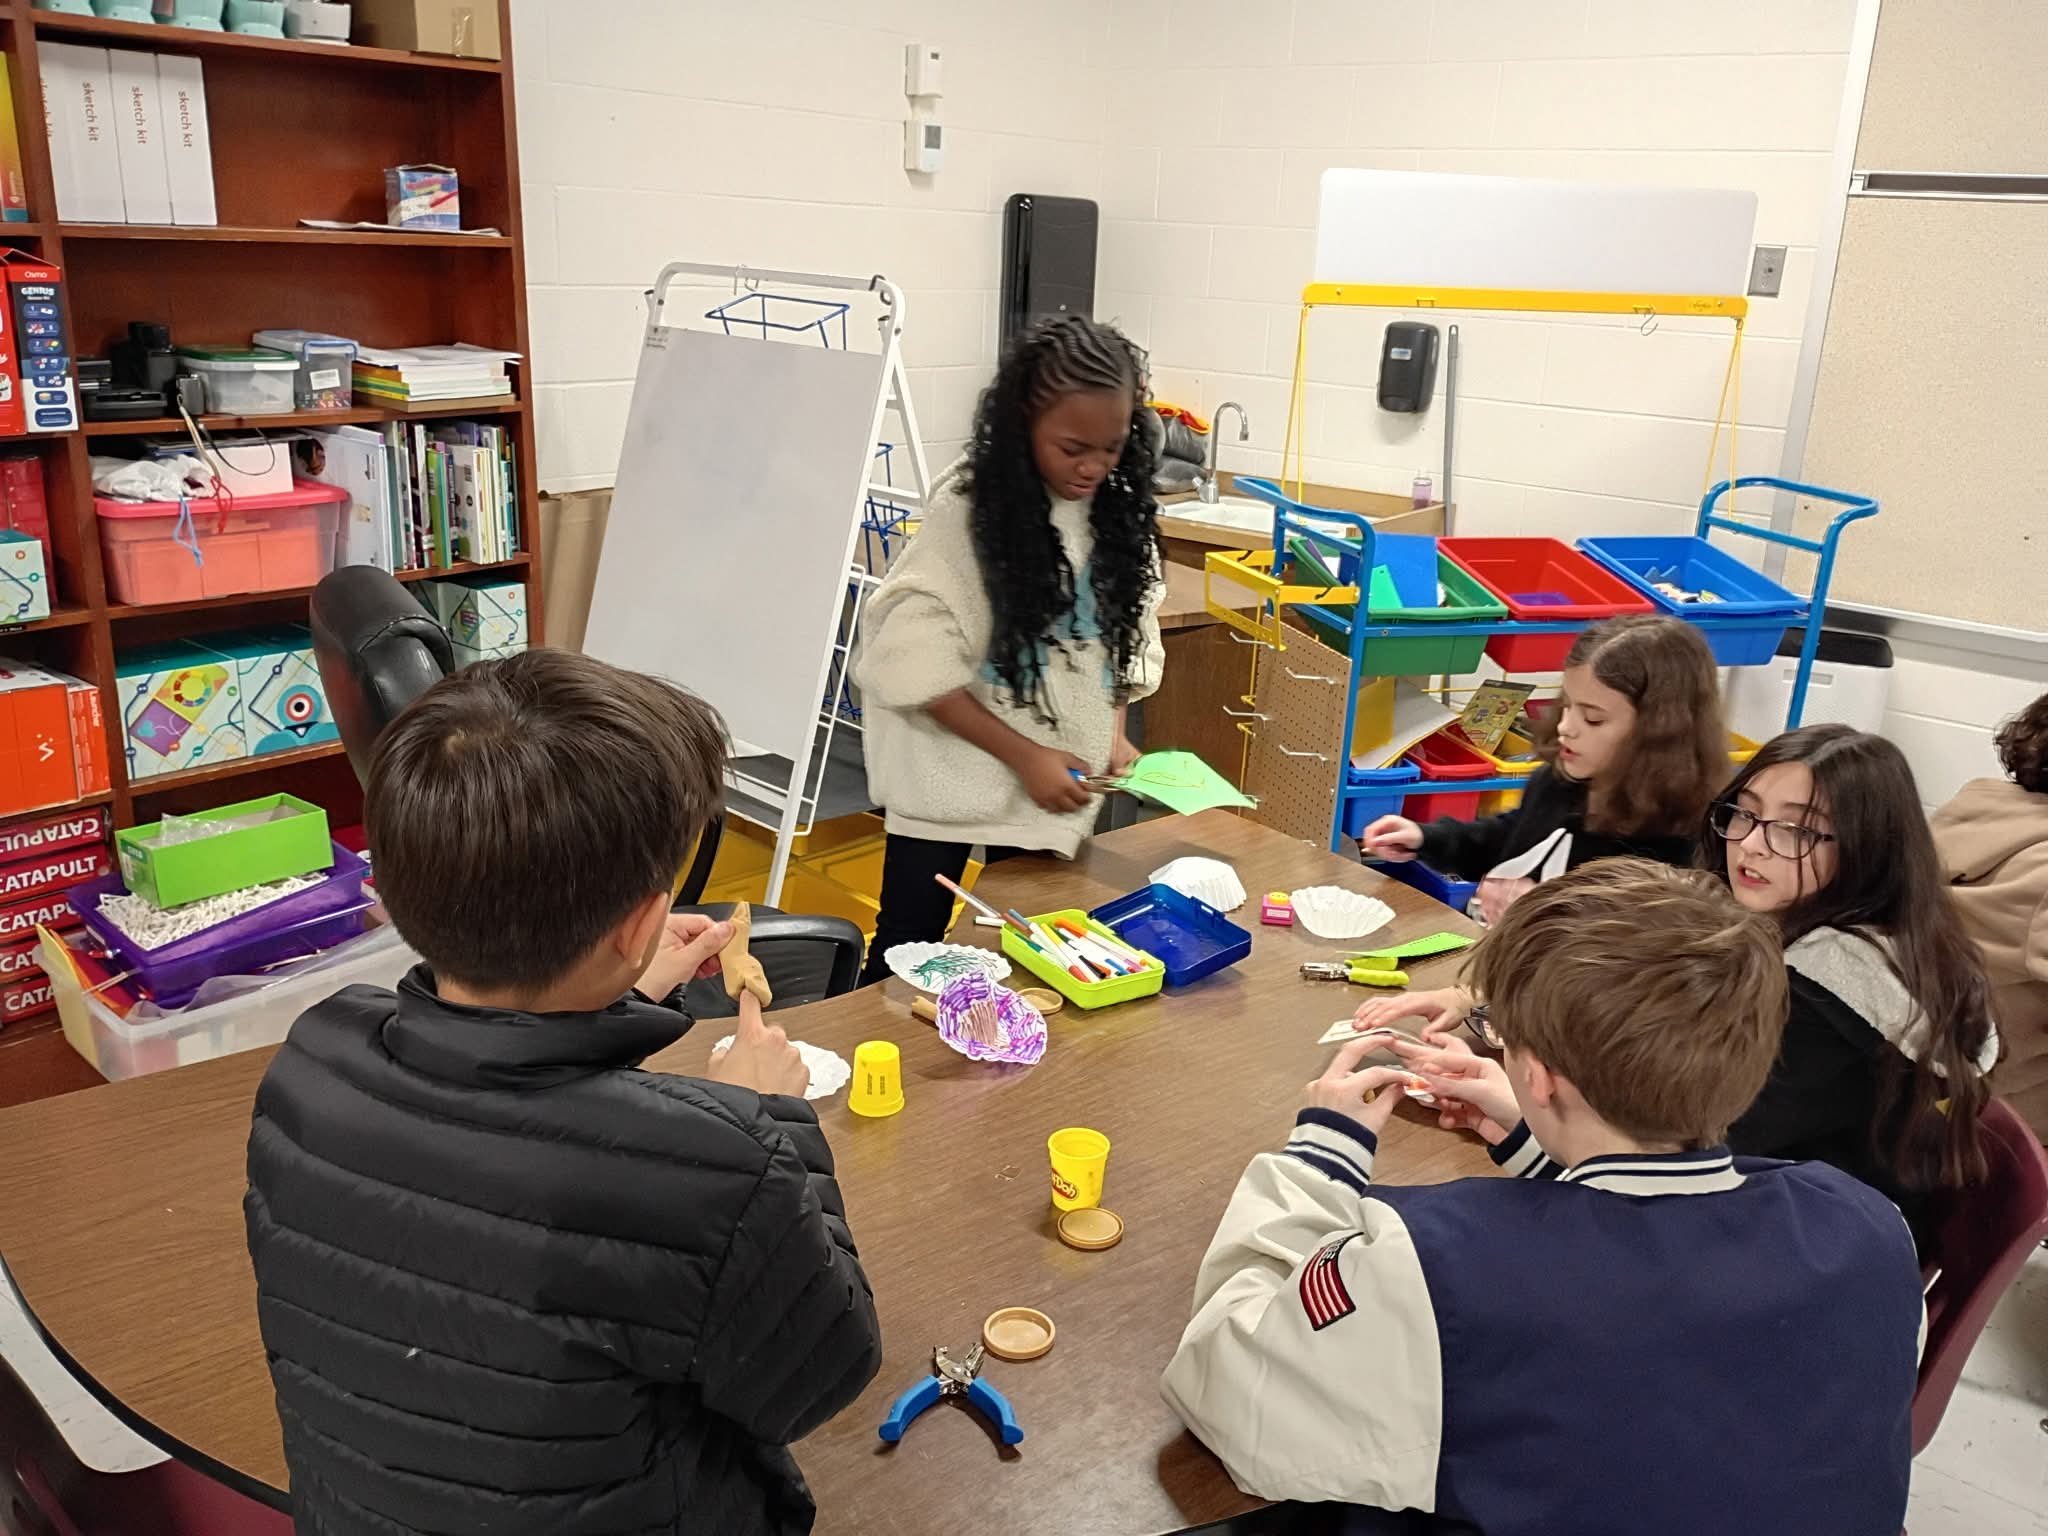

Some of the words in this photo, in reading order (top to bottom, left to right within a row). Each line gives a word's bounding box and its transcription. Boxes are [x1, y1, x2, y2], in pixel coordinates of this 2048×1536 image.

[82, 81, 98, 123] sketch
[132, 86, 146, 126] sketch
[178, 90, 192, 130] sketch
[88, 126, 99, 142] kit
[137, 129, 148, 144] kit
[183, 133, 193, 148] kit
[21, 286, 55, 297] GENIUS
[0, 855, 98, 894] ATAPULT
